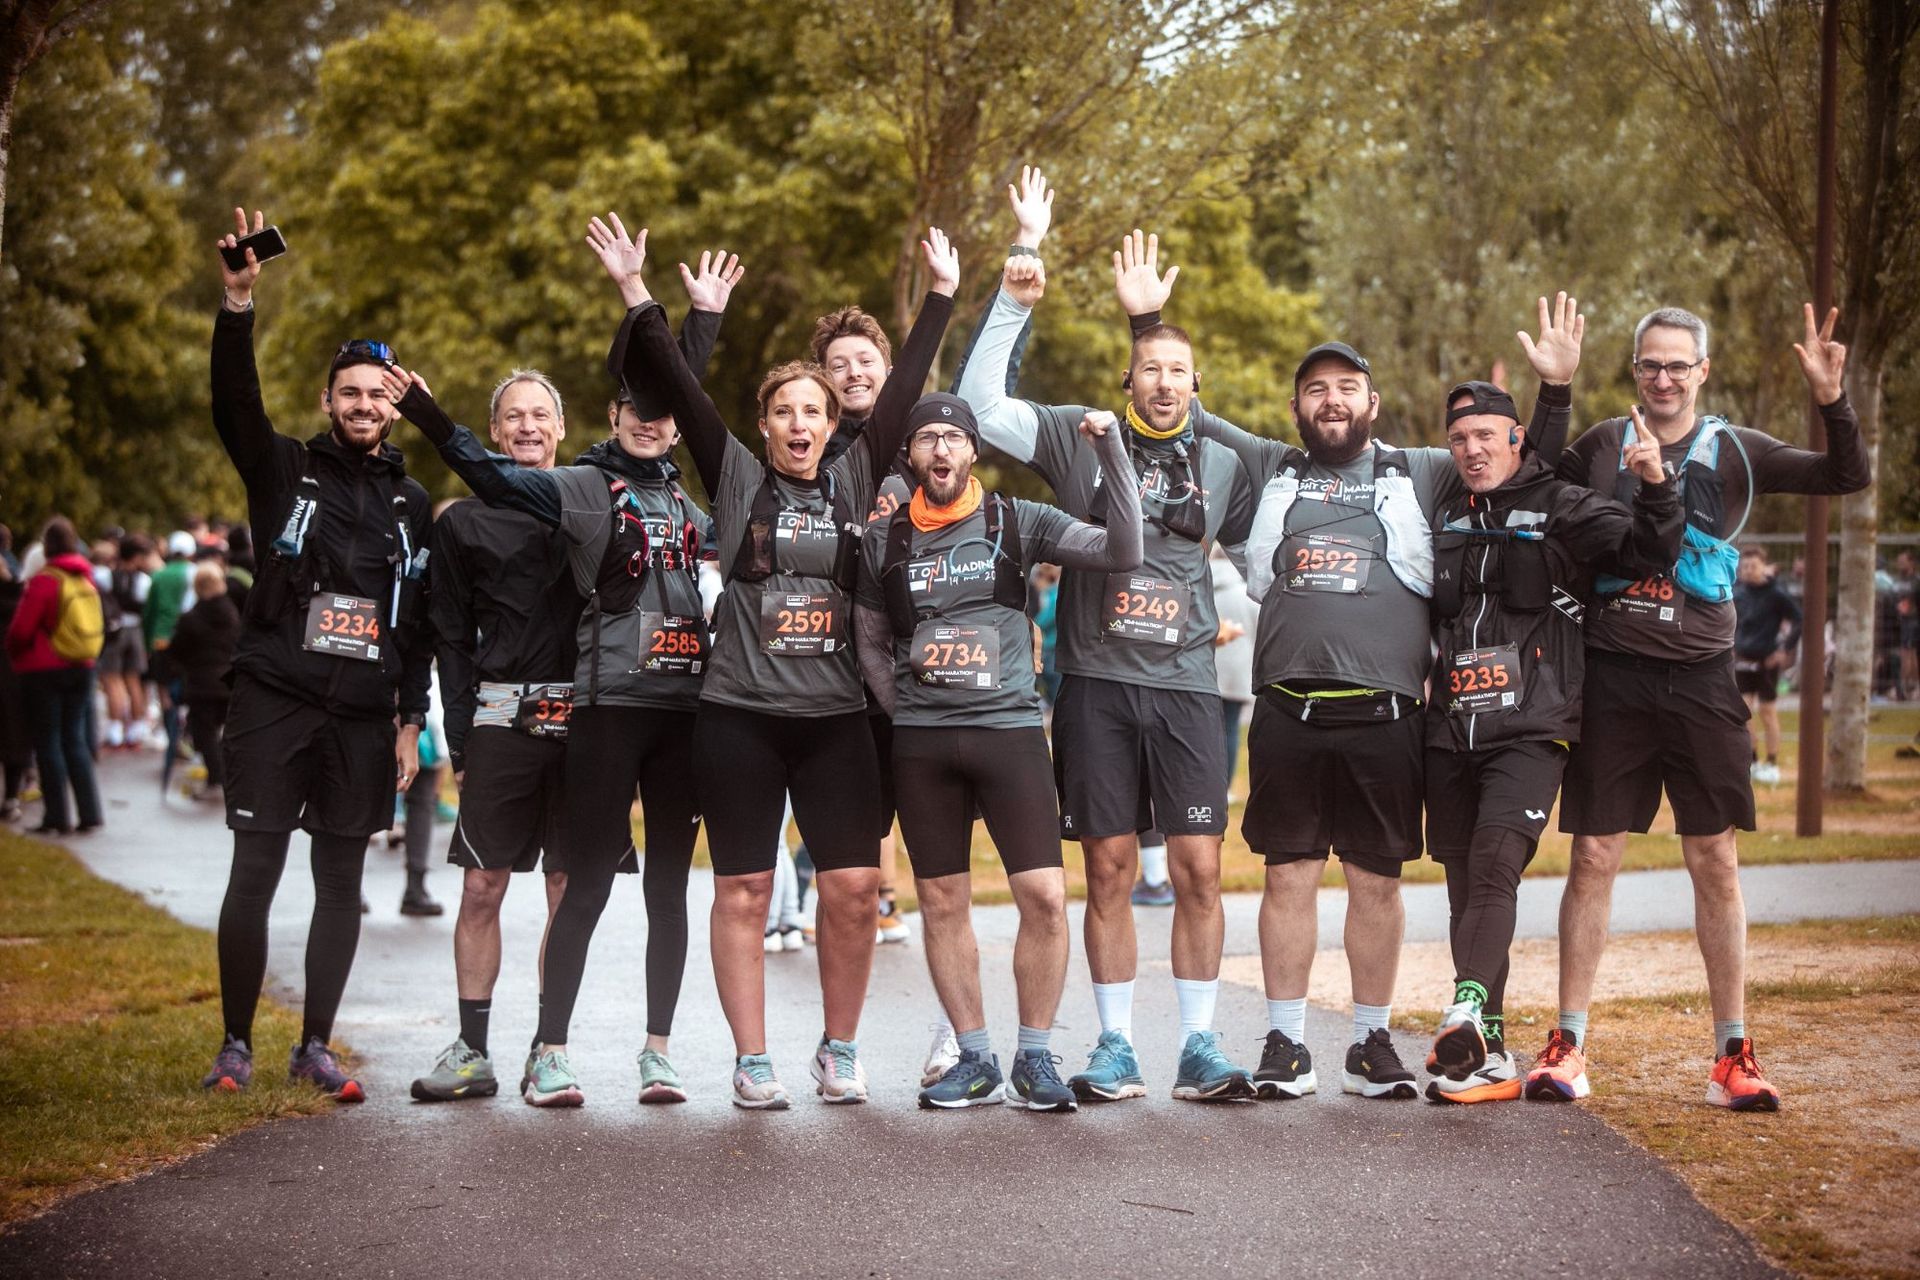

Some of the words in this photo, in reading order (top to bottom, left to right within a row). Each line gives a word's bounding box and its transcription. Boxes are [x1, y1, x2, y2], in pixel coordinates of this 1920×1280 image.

[814, 519, 837, 530] MAD
[1296, 548, 1358, 573] 2592
[985, 570, 996, 581] 20
[1624, 578, 1674, 600] 248
[1114, 592, 1179, 621] 3249
[319, 609, 379, 639] 3234
[776, 610, 832, 633] 2591
[650, 630, 700, 655] 2585
[923, 643, 988, 667] 2734
[1450, 664, 1509, 693] 3235
[535, 699, 573, 721] 32
